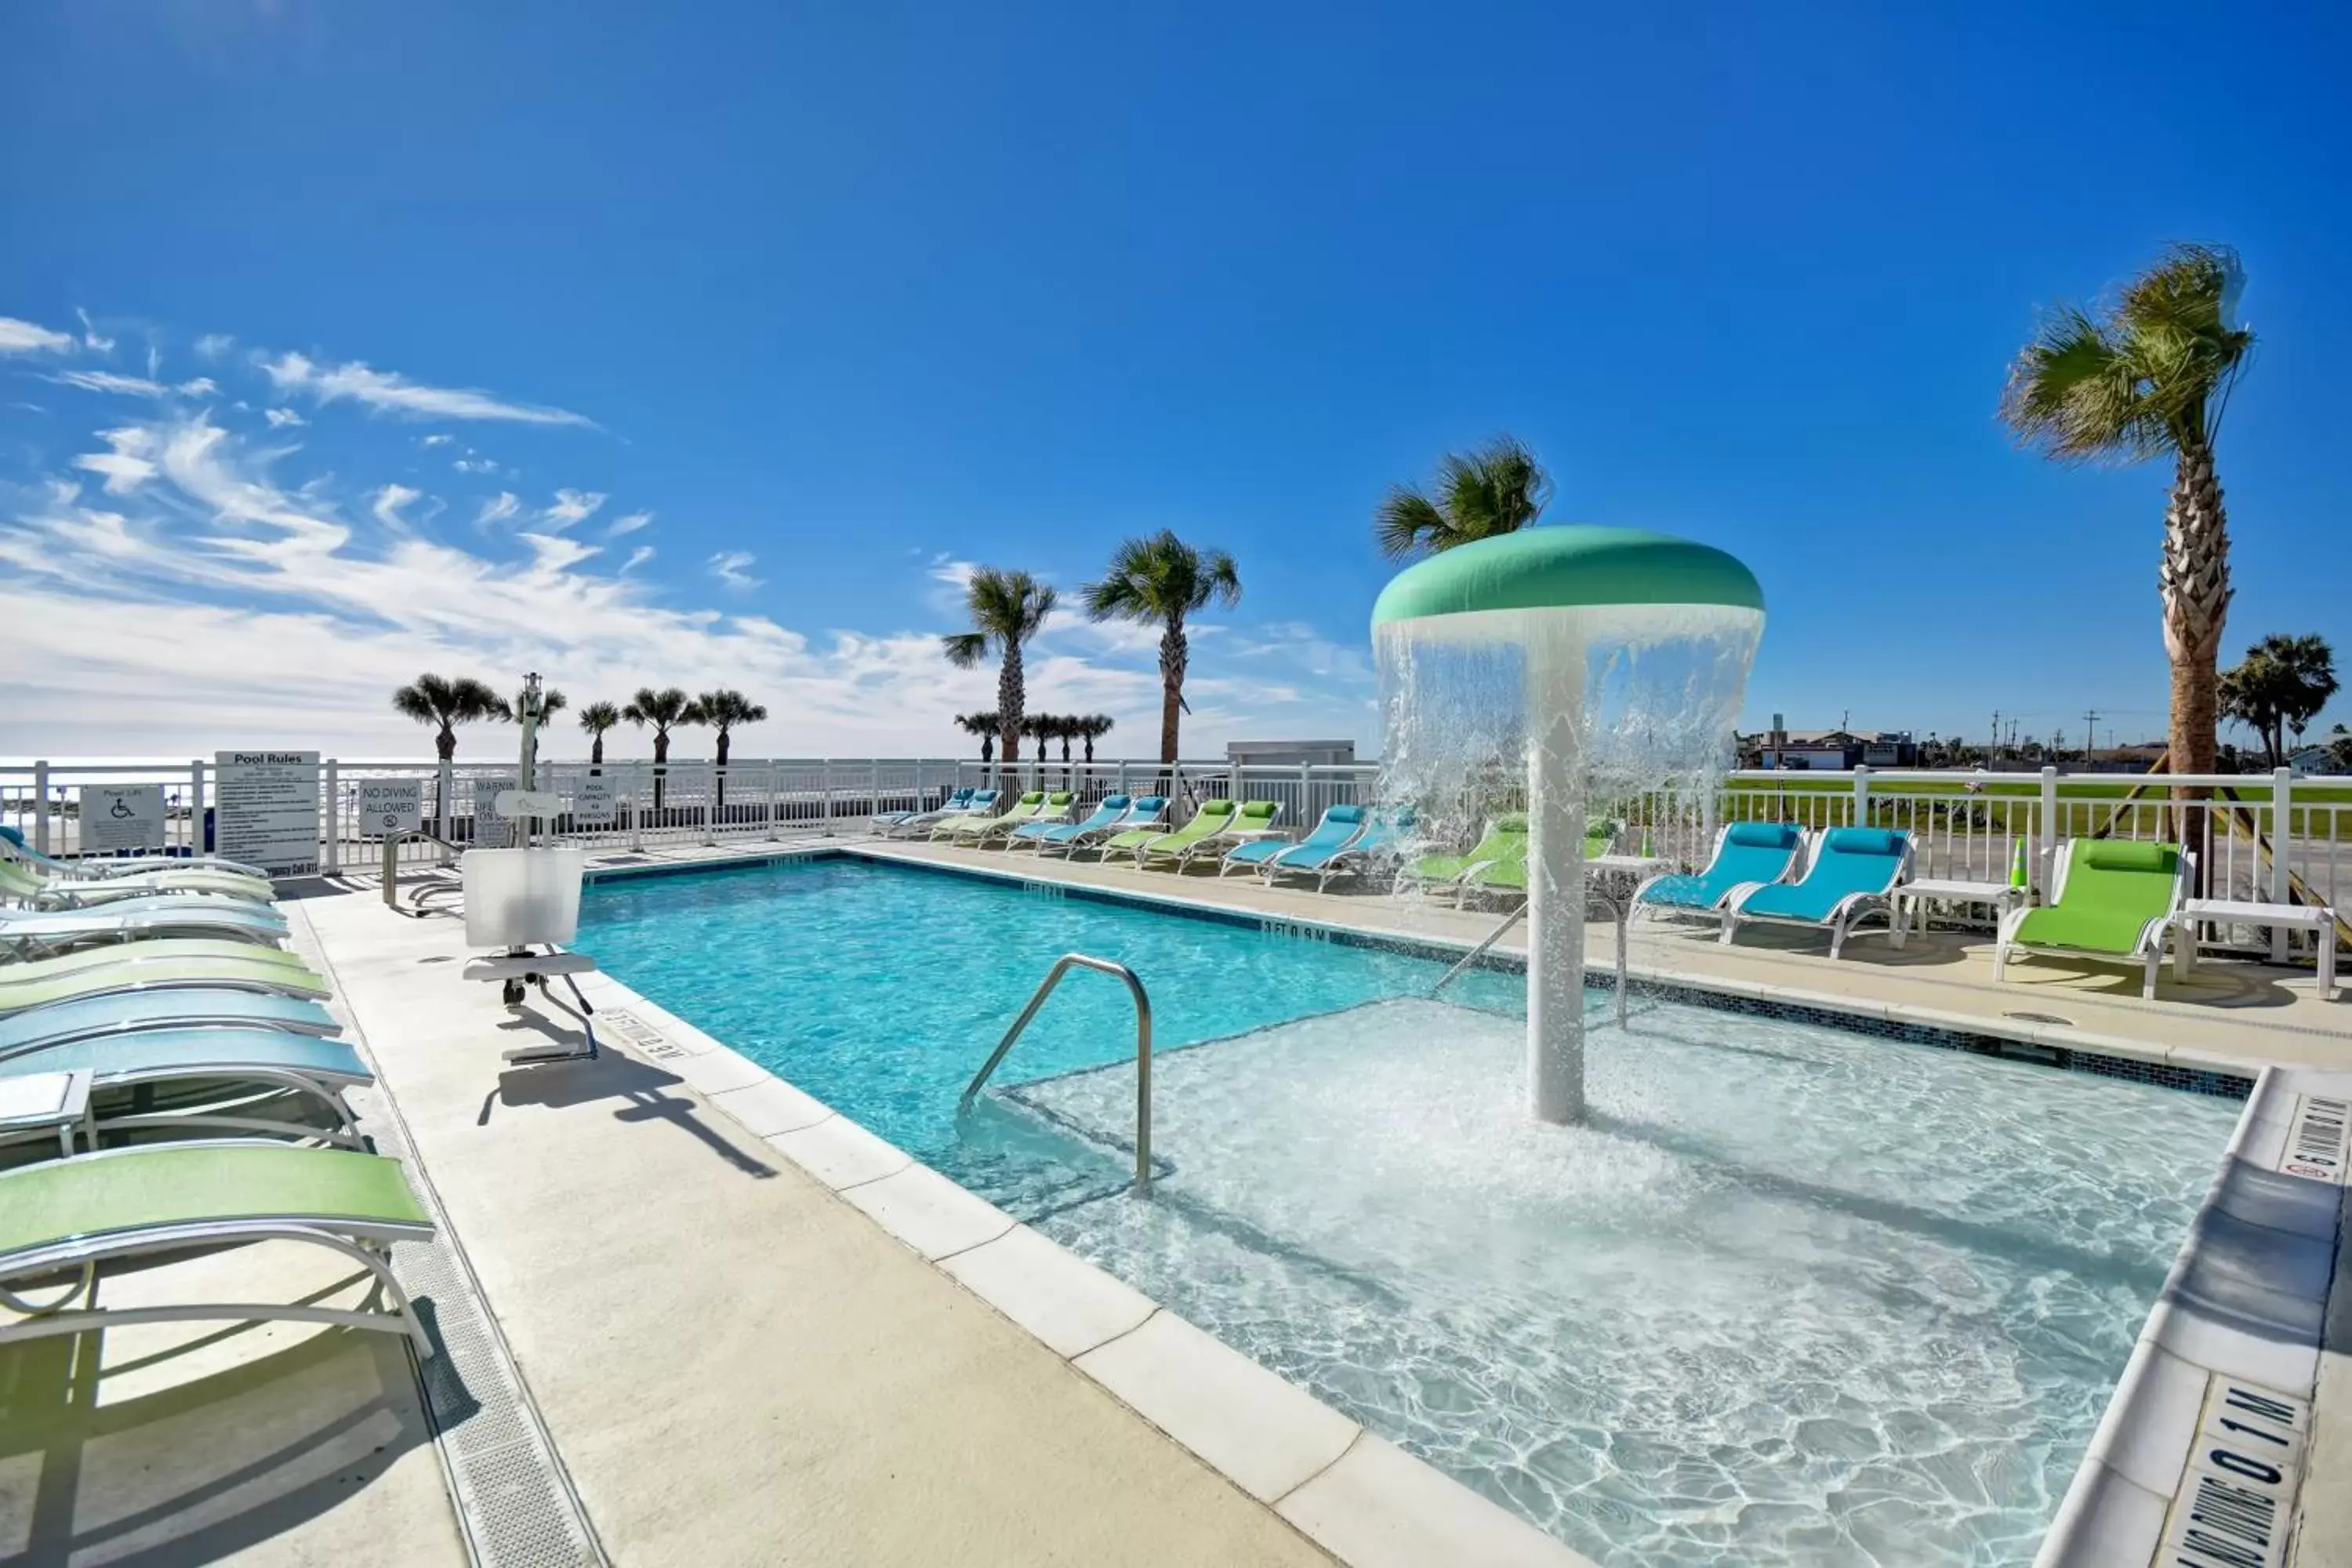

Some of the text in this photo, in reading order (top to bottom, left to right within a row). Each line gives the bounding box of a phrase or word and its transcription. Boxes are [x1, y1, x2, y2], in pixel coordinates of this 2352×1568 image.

[234, 753, 302, 764] Pool Rules
[476, 781, 515, 791] WARNIN
[363, 786, 417, 798] NO DIVING
[366, 802, 415, 813] ALLOWED
[2182, 1475, 2276, 1568] NO DIVING
